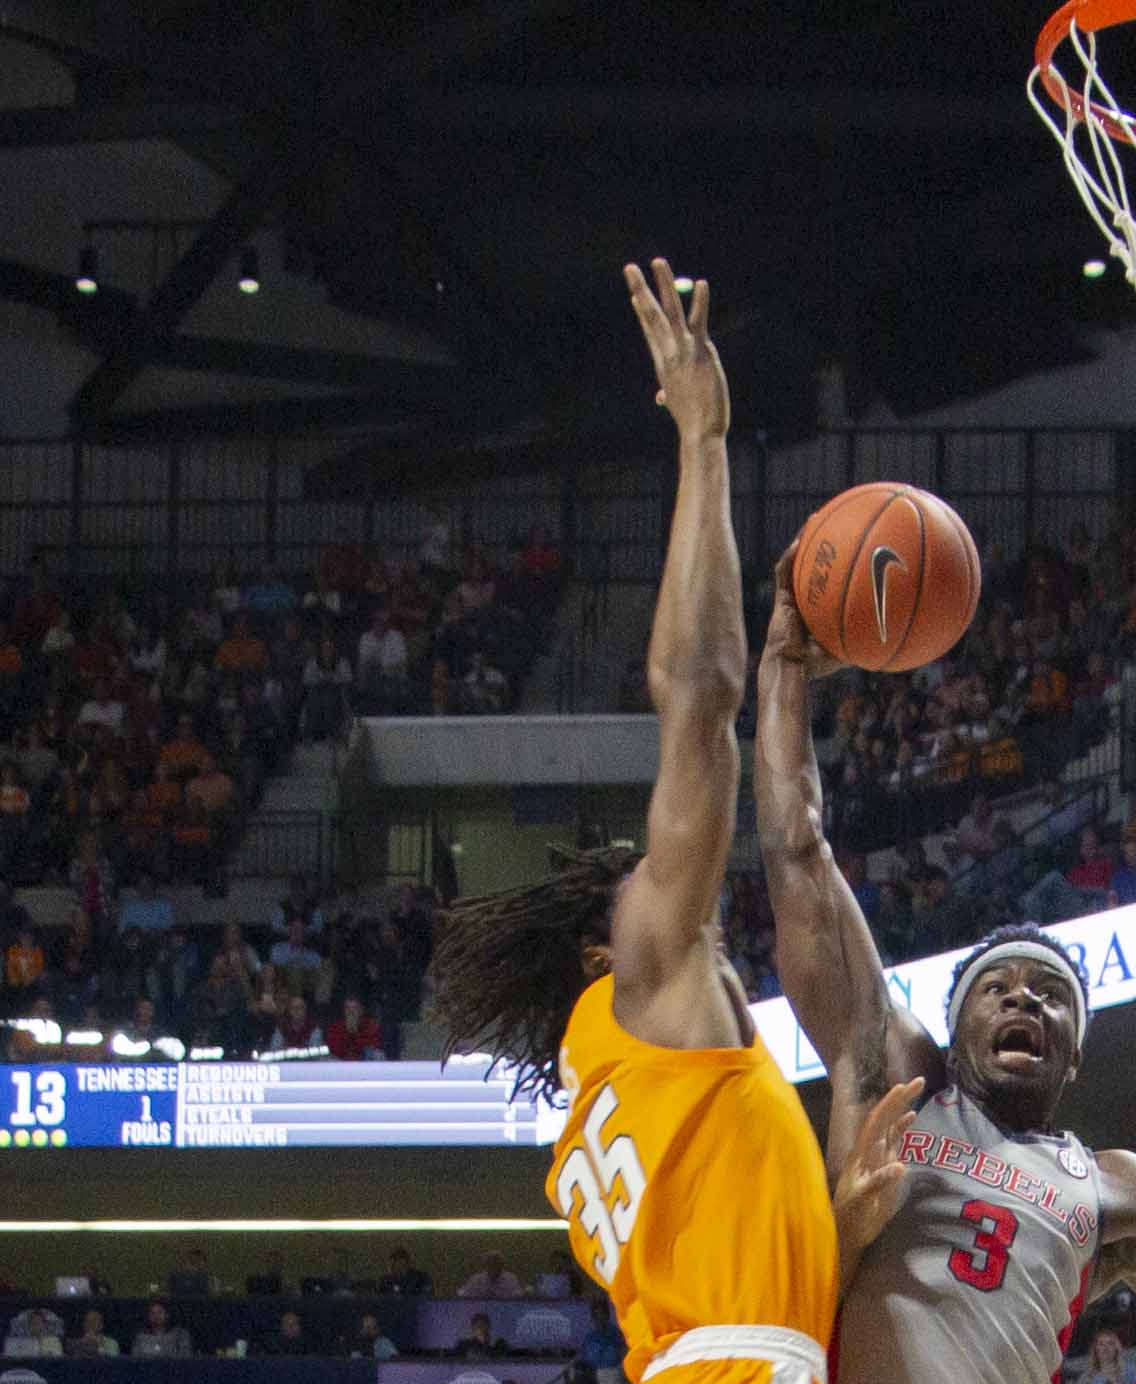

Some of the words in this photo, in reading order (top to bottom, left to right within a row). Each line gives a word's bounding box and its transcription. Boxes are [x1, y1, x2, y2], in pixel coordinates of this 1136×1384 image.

[9, 1071, 67, 1126] 13
[77, 1067, 177, 1091] TENNESSEE
[121, 1121, 171, 1146] FOULS
[141, 1095, 152, 1122] 1
[556, 1081, 648, 1286] 35
[897, 1128, 1098, 1248] REBELS
[946, 1199, 1021, 1293] 3
